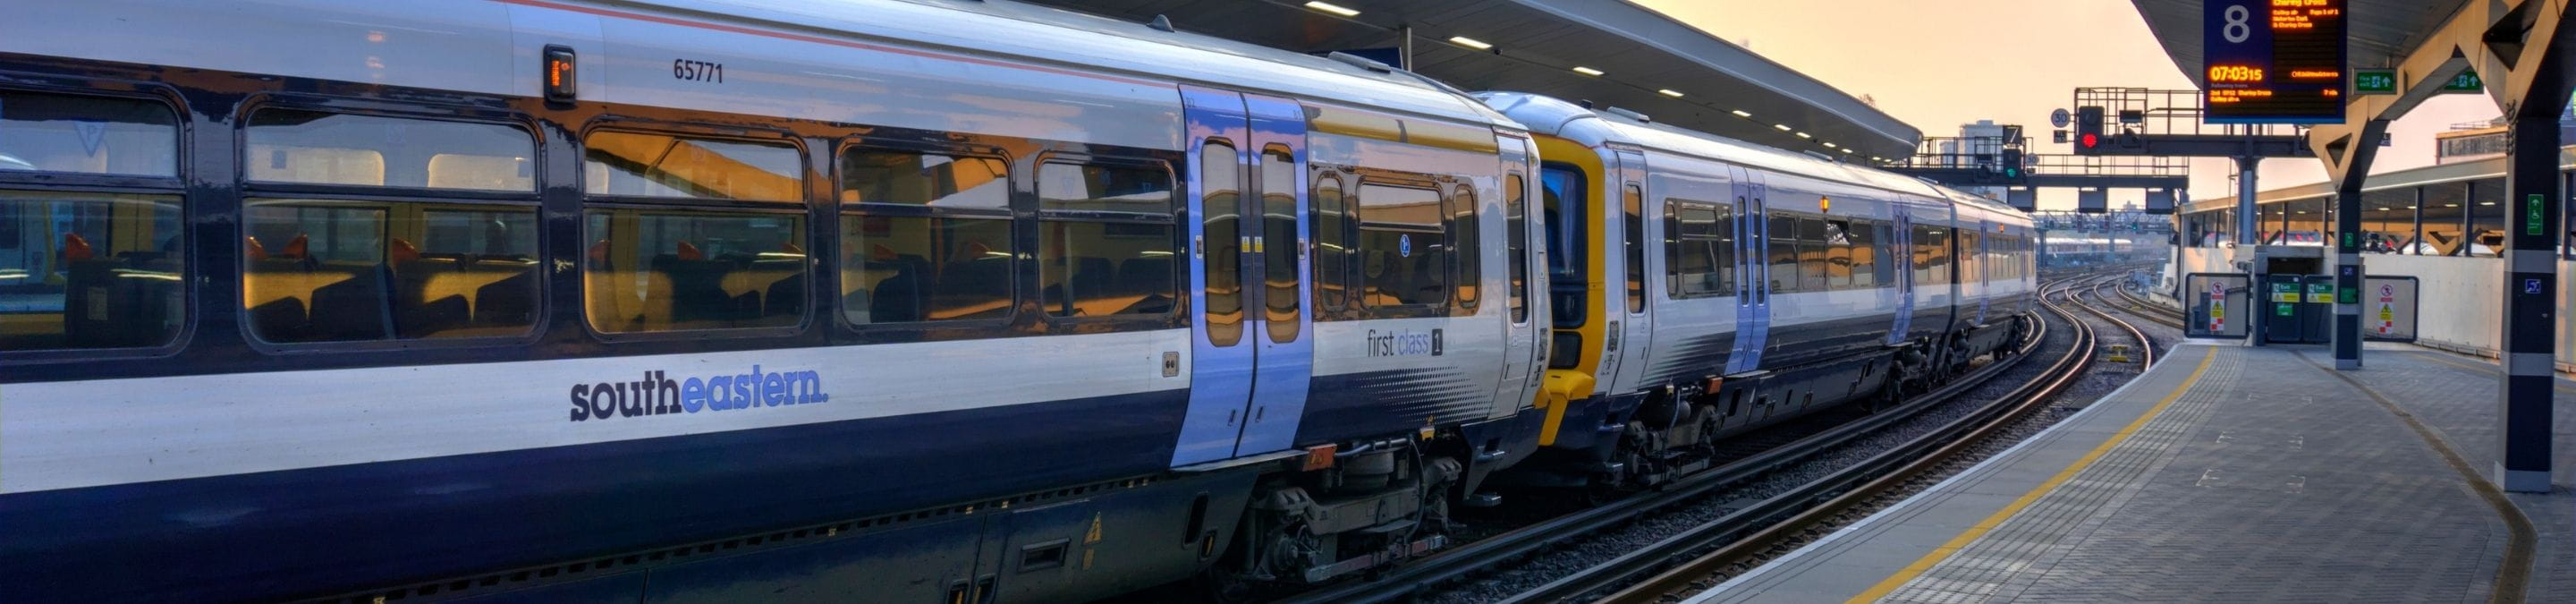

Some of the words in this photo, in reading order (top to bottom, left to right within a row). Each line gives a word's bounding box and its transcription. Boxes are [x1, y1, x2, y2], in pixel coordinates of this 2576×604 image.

[2224, 4, 2250, 43] 8
[674, 58, 722, 83] 65771
[2055, 114, 2067, 123] 30
[1368, 328, 1394, 357] first
[1398, 328, 1428, 355] class
